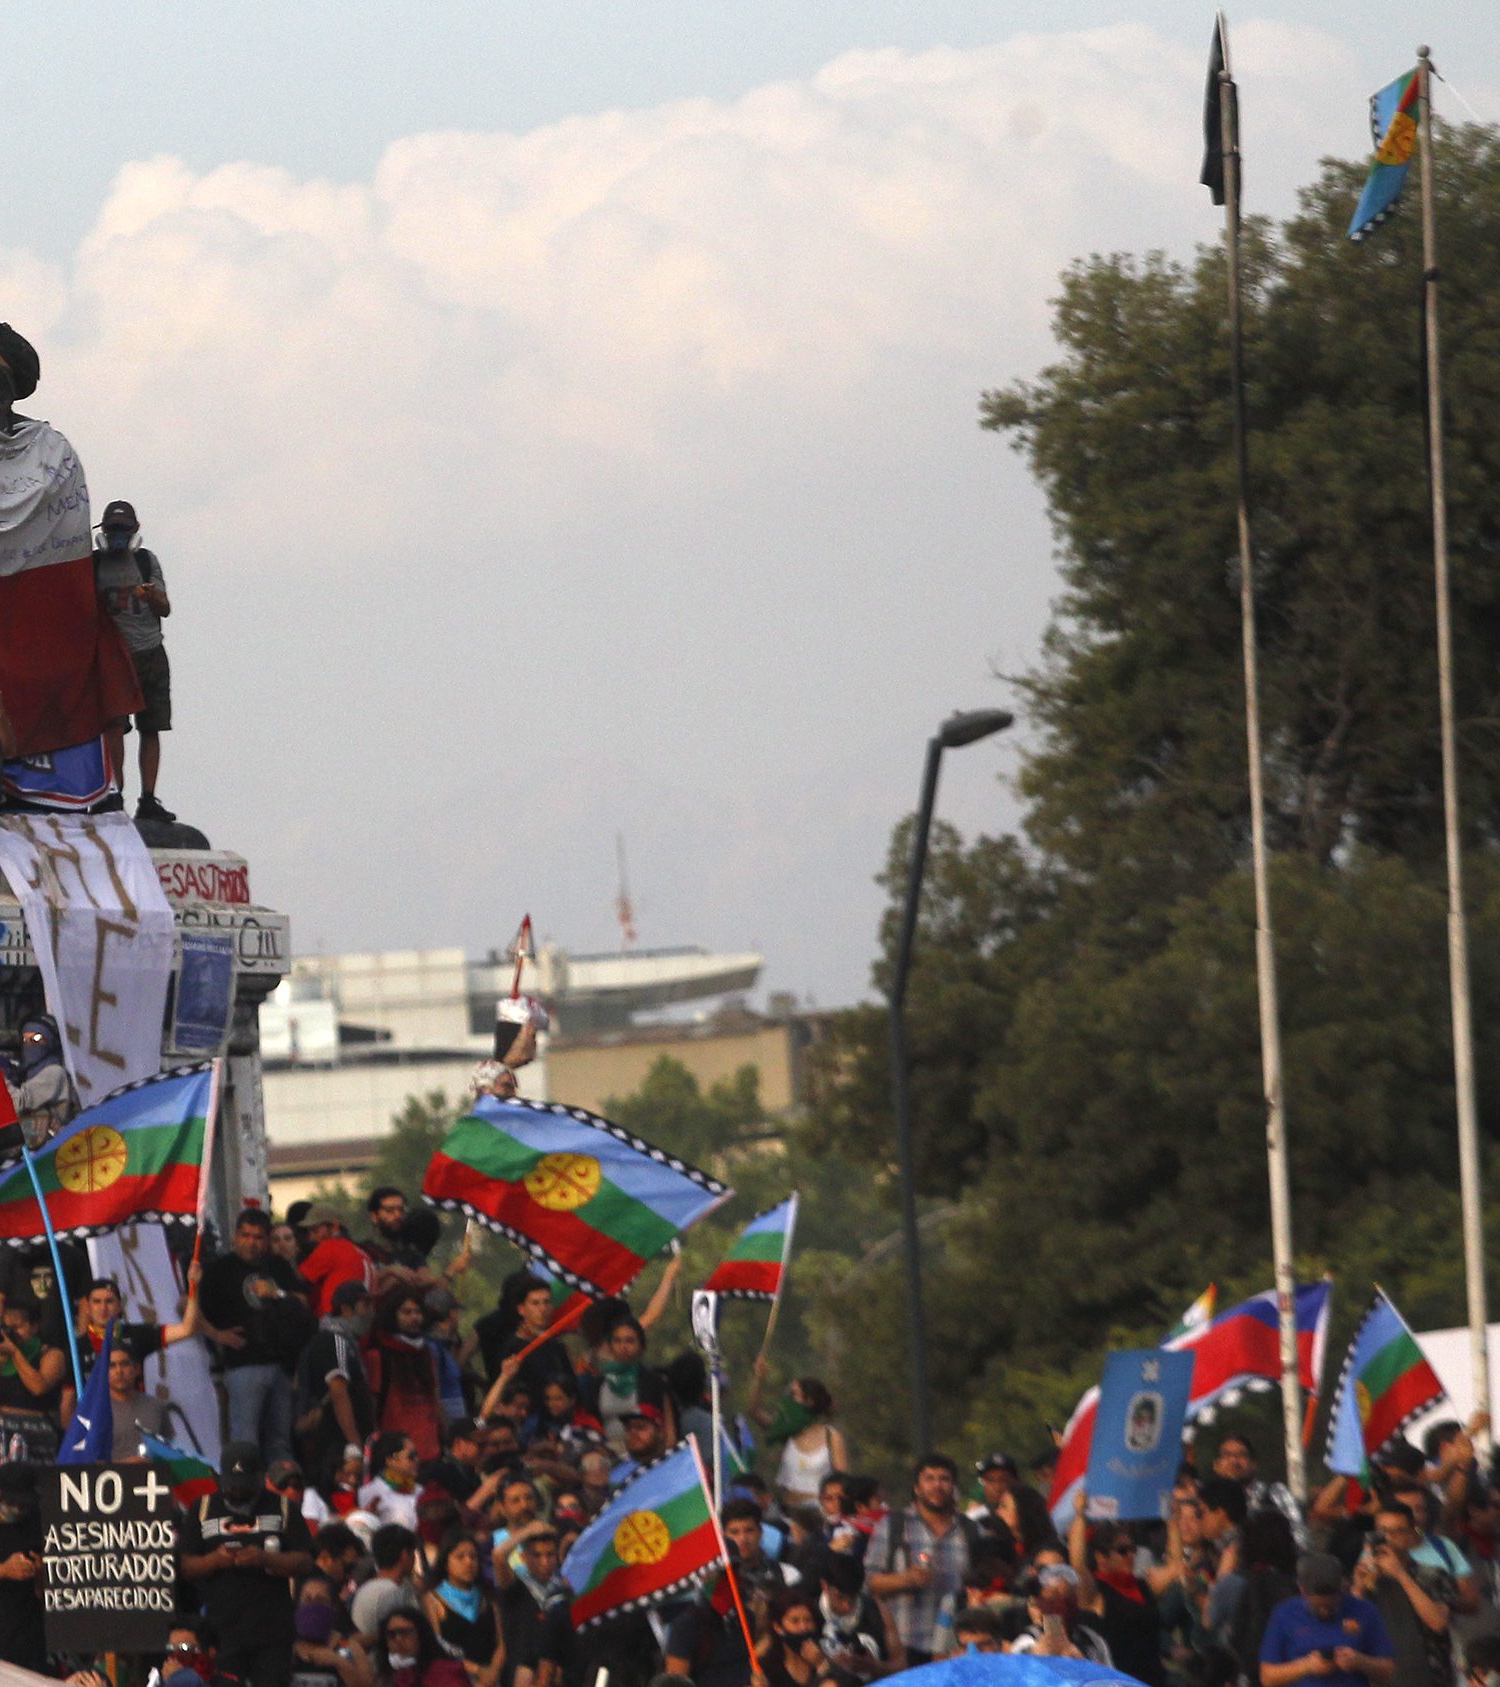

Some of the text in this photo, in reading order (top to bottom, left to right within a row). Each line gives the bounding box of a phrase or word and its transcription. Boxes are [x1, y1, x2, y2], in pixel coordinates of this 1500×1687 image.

[59, 1469, 123, 1514] NO
[43, 1519, 175, 1553] ASESINADOS
[42, 1552, 176, 1584] TORTURADOS
[44, 1586, 175, 1612] DESAPARECIDOS
